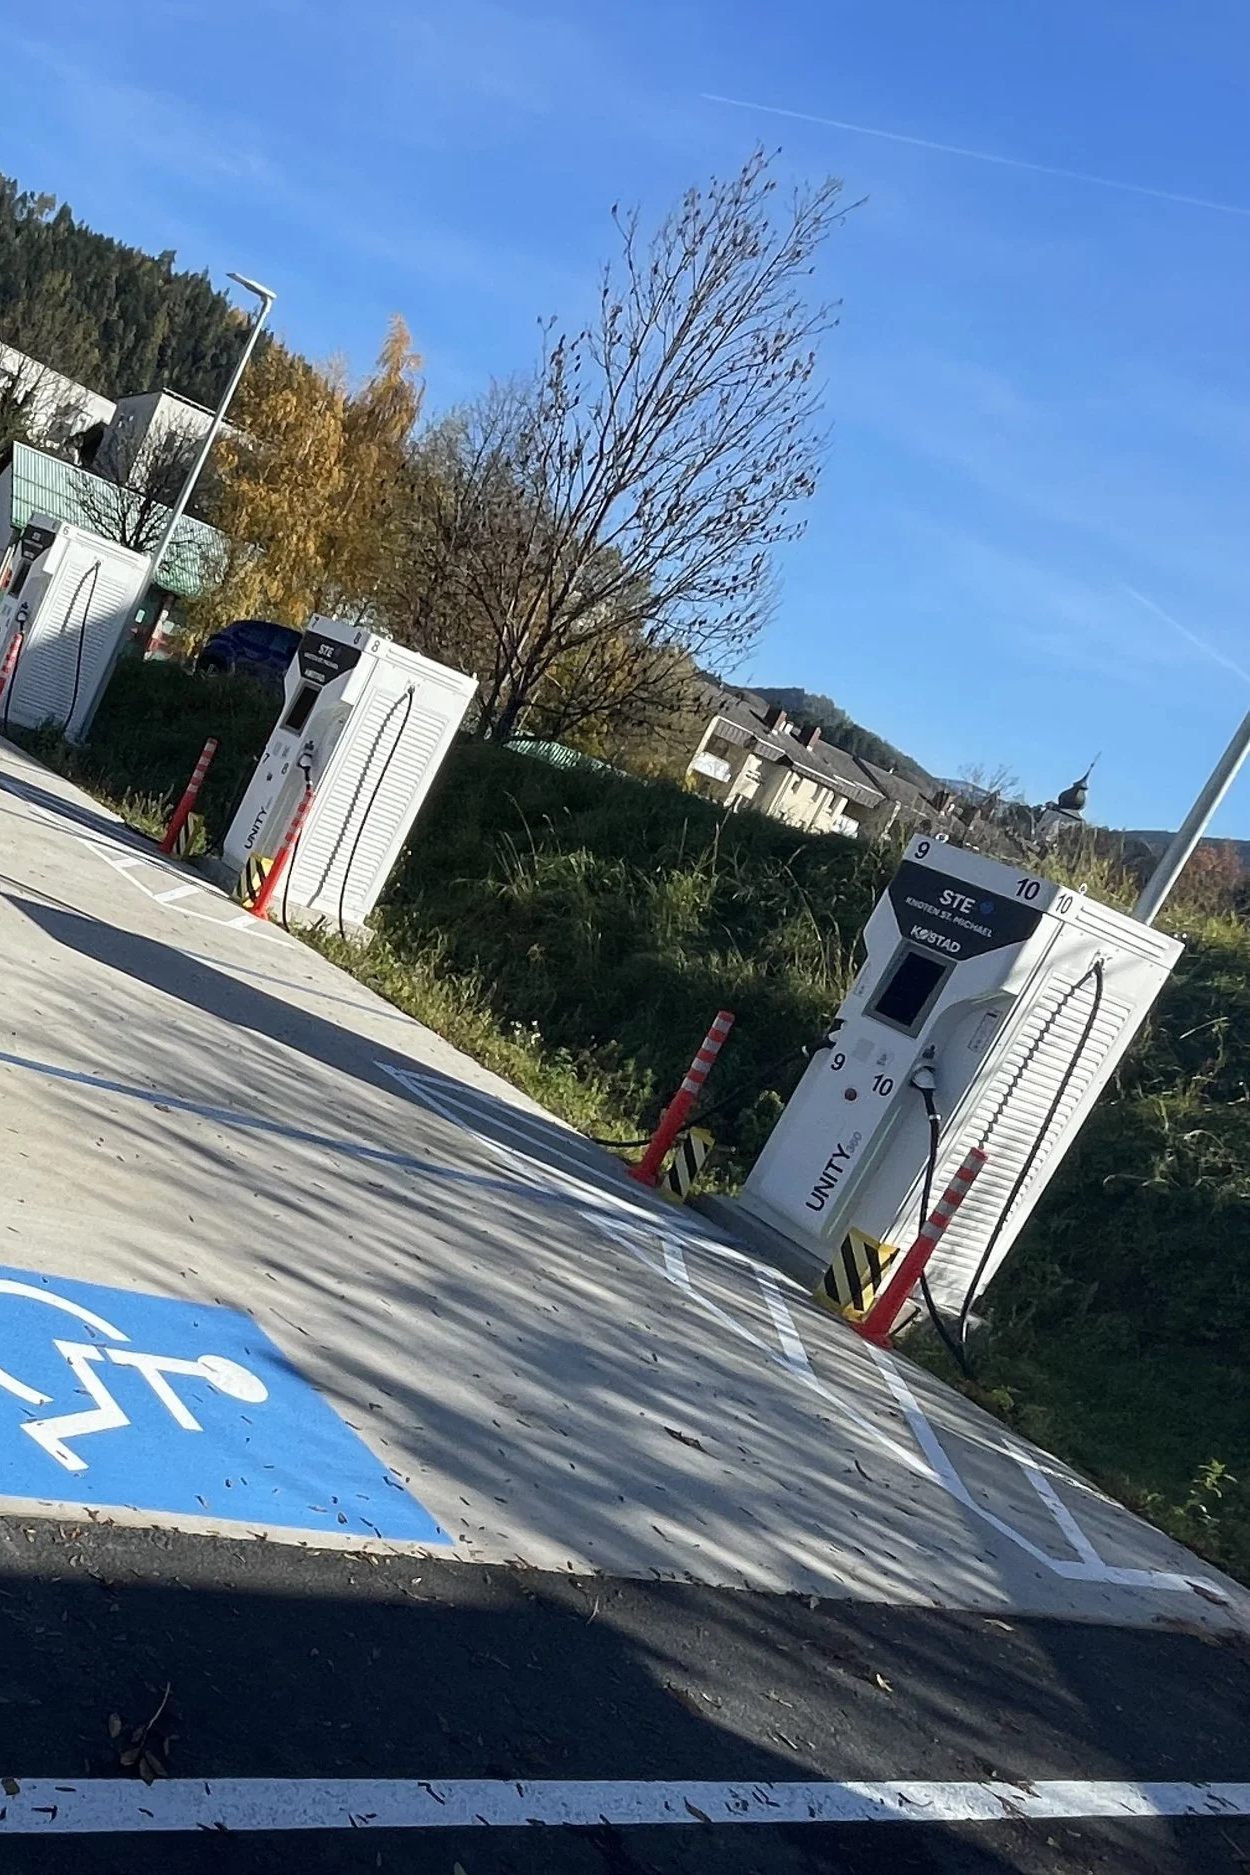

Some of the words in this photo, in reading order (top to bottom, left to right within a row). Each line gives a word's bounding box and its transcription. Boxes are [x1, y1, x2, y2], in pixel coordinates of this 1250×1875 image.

[63, 526, 70, 536] 6
[371, 640, 380, 652] 8
[262, 753, 271, 763] 7
[281, 763, 289, 775] 8
[244, 806, 267, 850] UNITY
[914, 842, 930, 859] 9
[1016, 878, 1040, 900] 10
[939, 890, 976, 913] STE
[1055, 894, 1073, 914] 10
[905, 897, 939, 916] KNOTEN
[940, 909, 953, 921] ST.
[953, 917, 993, 938] MICHAEL
[831, 1053, 846, 1071] 9
[872, 1074, 893, 1096] 10
[806, 1143, 850, 1212] UNITY
